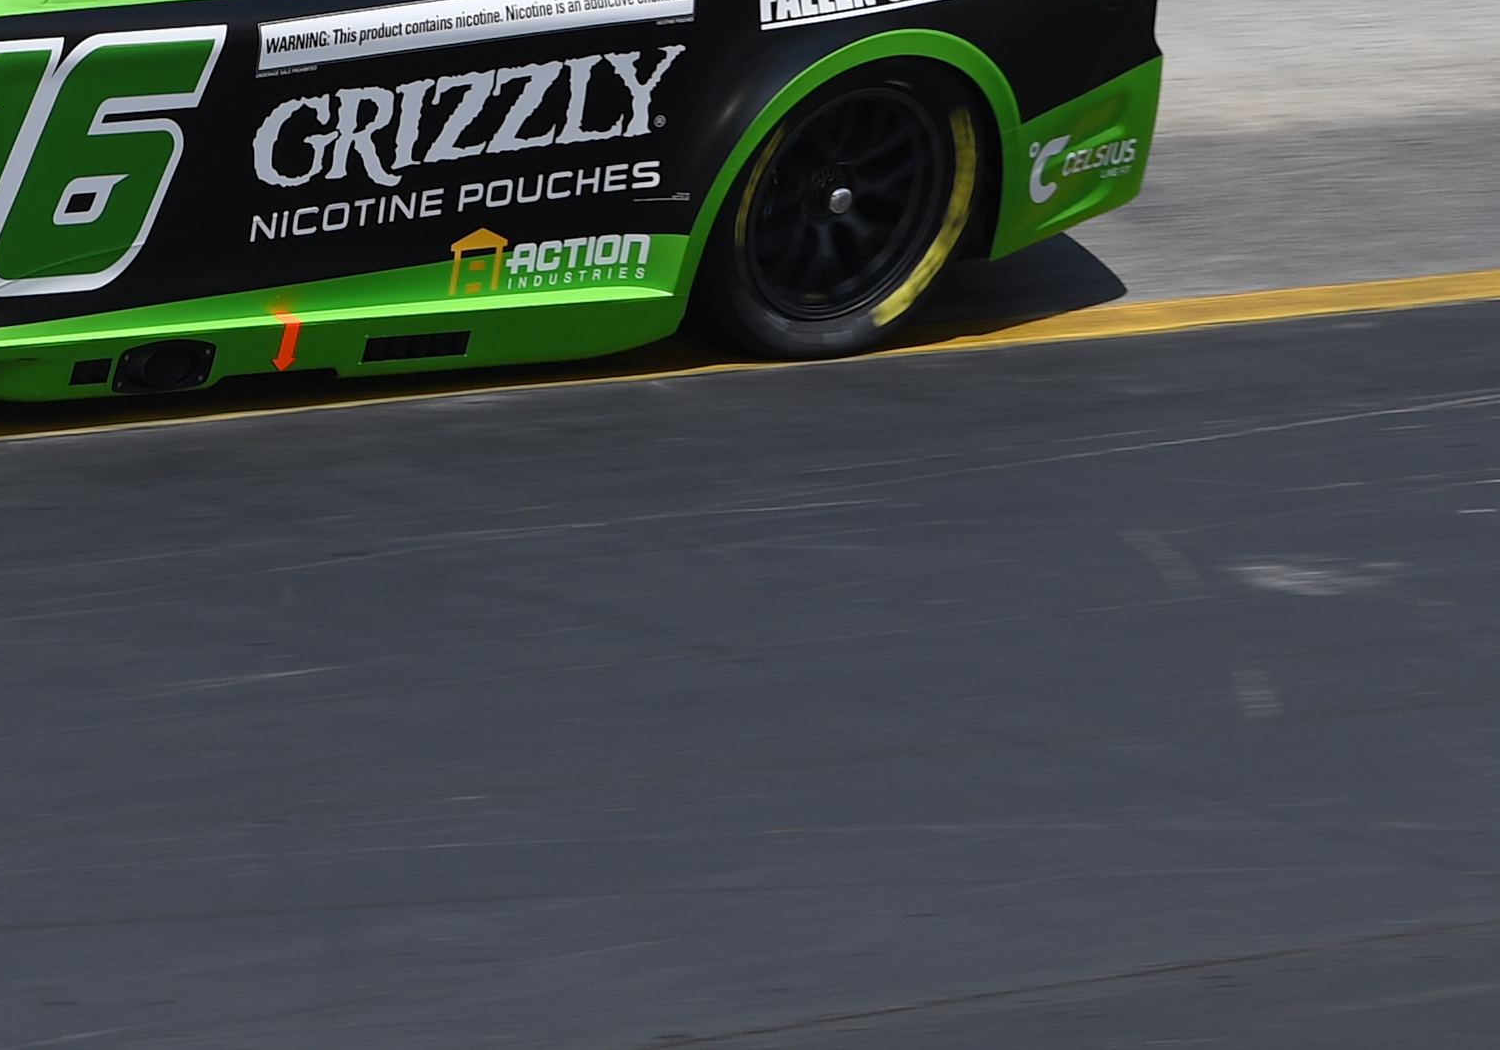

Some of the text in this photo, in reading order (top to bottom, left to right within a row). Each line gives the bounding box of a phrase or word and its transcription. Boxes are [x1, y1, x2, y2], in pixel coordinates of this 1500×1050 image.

[266, 32, 331, 54] WARNING:
[333, 27, 357, 45] This
[358, 22, 403, 46] product
[405, 14, 453, 35] contains
[455, 8, 504, 29] nicotine.
[505, 0, 553, 22] Nicotine
[555, 0, 566, 15] is
[567, 0, 582, 13] an
[252, 44, 686, 187] GRIZZLY
[1062, 138, 1138, 177] CELSIUS
[249, 161, 660, 243] NICOTINE POUCHES
[505, 234, 651, 275] ACTION
[507, 267, 646, 290] INDUSTRIES
